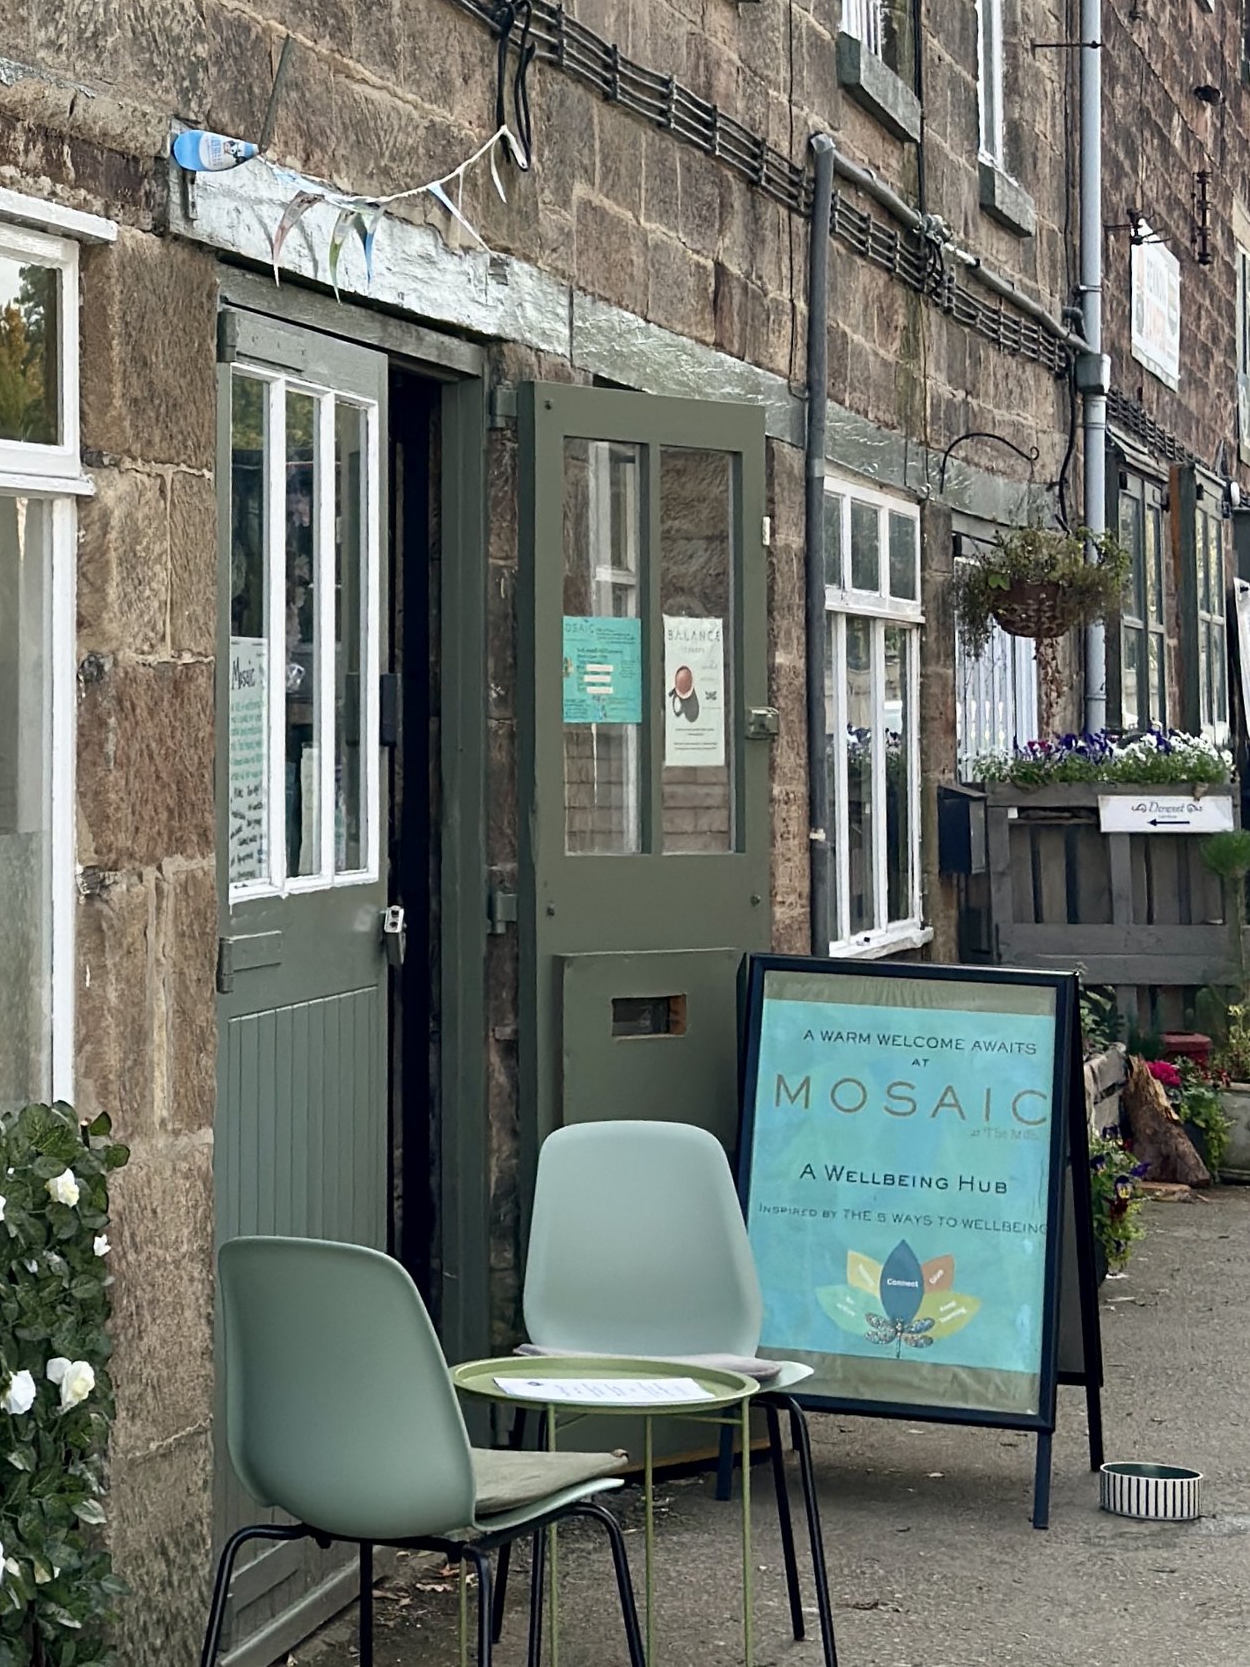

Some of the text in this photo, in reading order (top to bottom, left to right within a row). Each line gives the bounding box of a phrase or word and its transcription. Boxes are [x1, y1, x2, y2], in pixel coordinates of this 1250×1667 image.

[803, 1029, 1037, 1056] A WARM WELCOME AWAITS
[911, 1058, 930, 1068] AT
[775, 1073, 1047, 1126] MOSAIC
[799, 1163, 1009, 1195] A WELLBEING HUB
[822, 1209, 838, 1219] BY
[843, 1209, 873, 1223] THE
[892, 1213, 934, 1227] WAYS
[938, 1216, 959, 1229] TO
[887, 1278, 919, 1289] Connect
